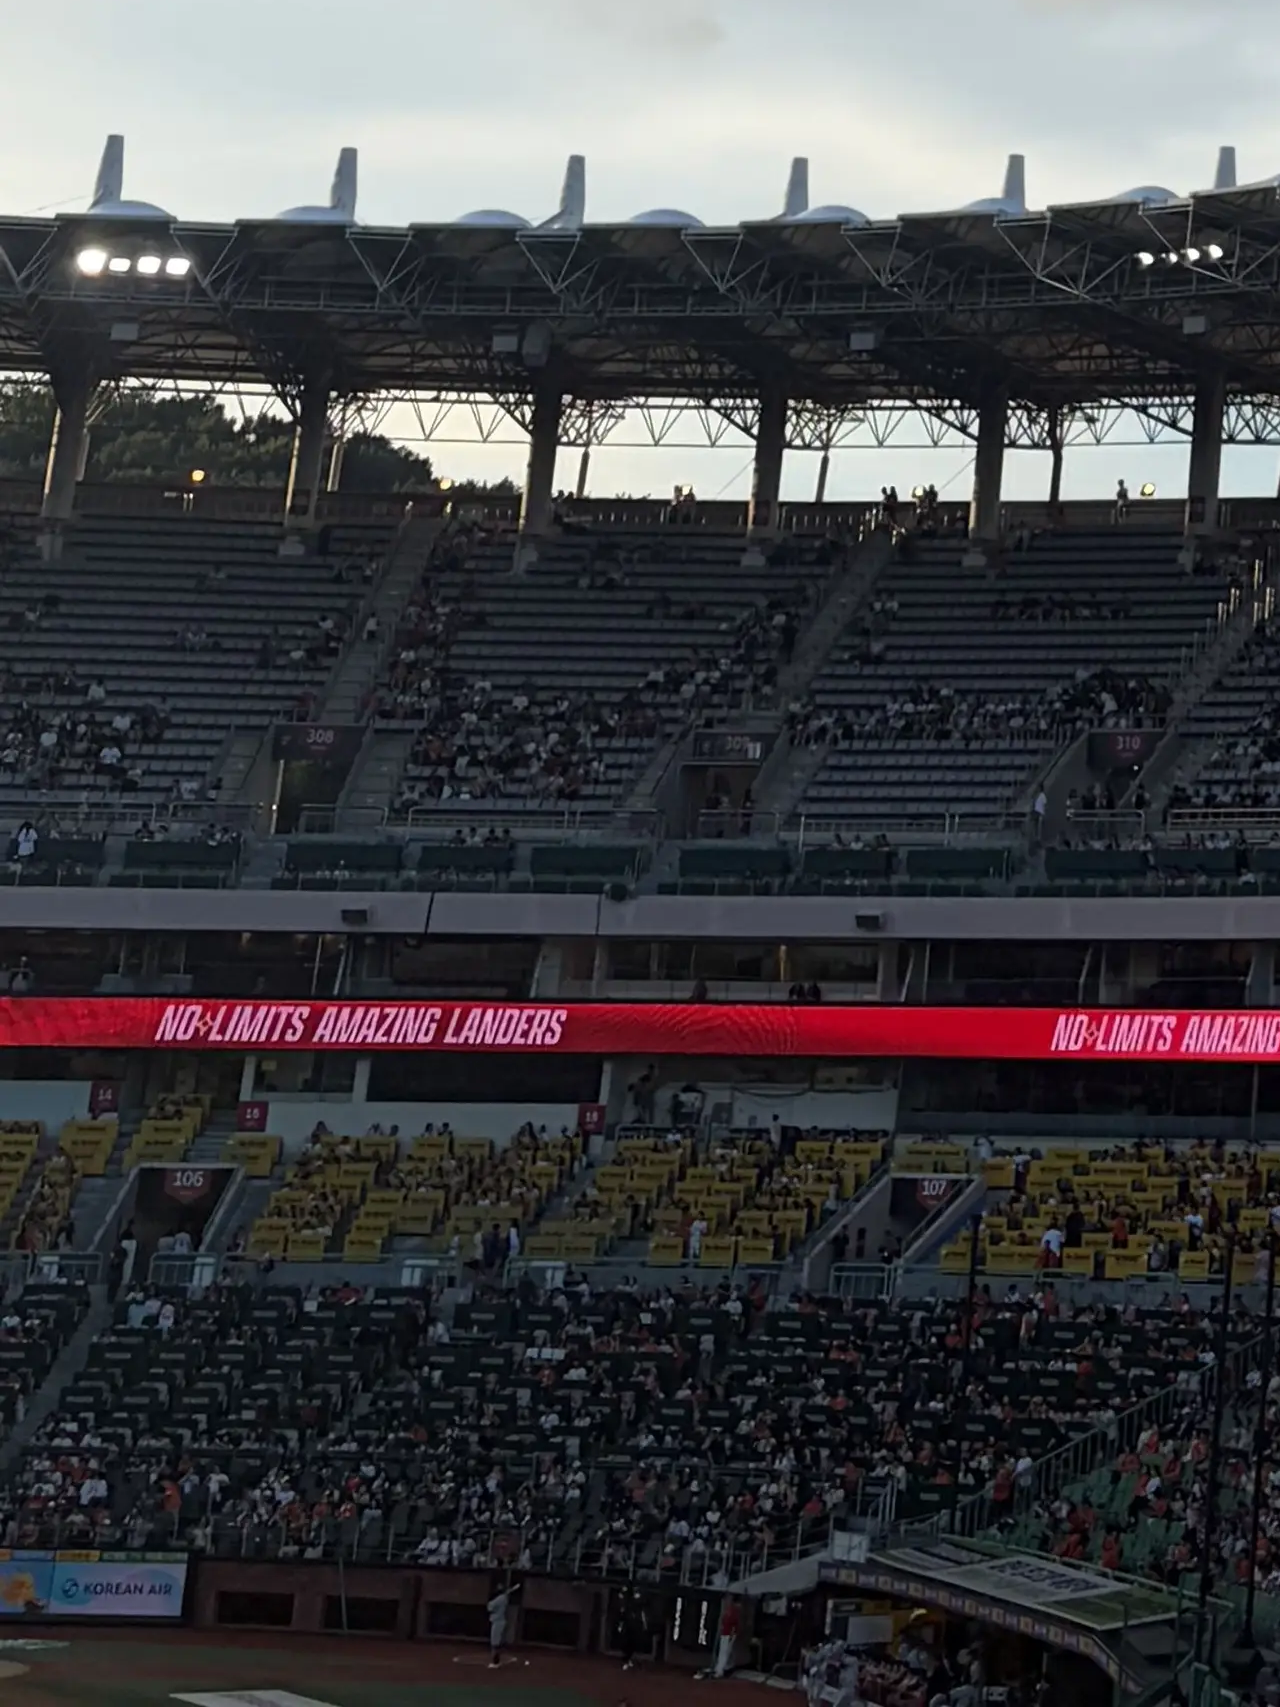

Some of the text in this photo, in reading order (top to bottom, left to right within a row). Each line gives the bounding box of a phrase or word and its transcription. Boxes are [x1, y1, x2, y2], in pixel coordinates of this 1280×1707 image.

[154, 1004, 568, 1045] NO LIMITS AMAZING LANDERS
[1050, 1014, 1089, 1051] NO
[1094, 1015, 1178, 1052] LIMITS
[172, 1171, 204, 1187] 106
[922, 1179, 948, 1196] 107
[84, 1582, 173, 1596] KOREAN AIR
